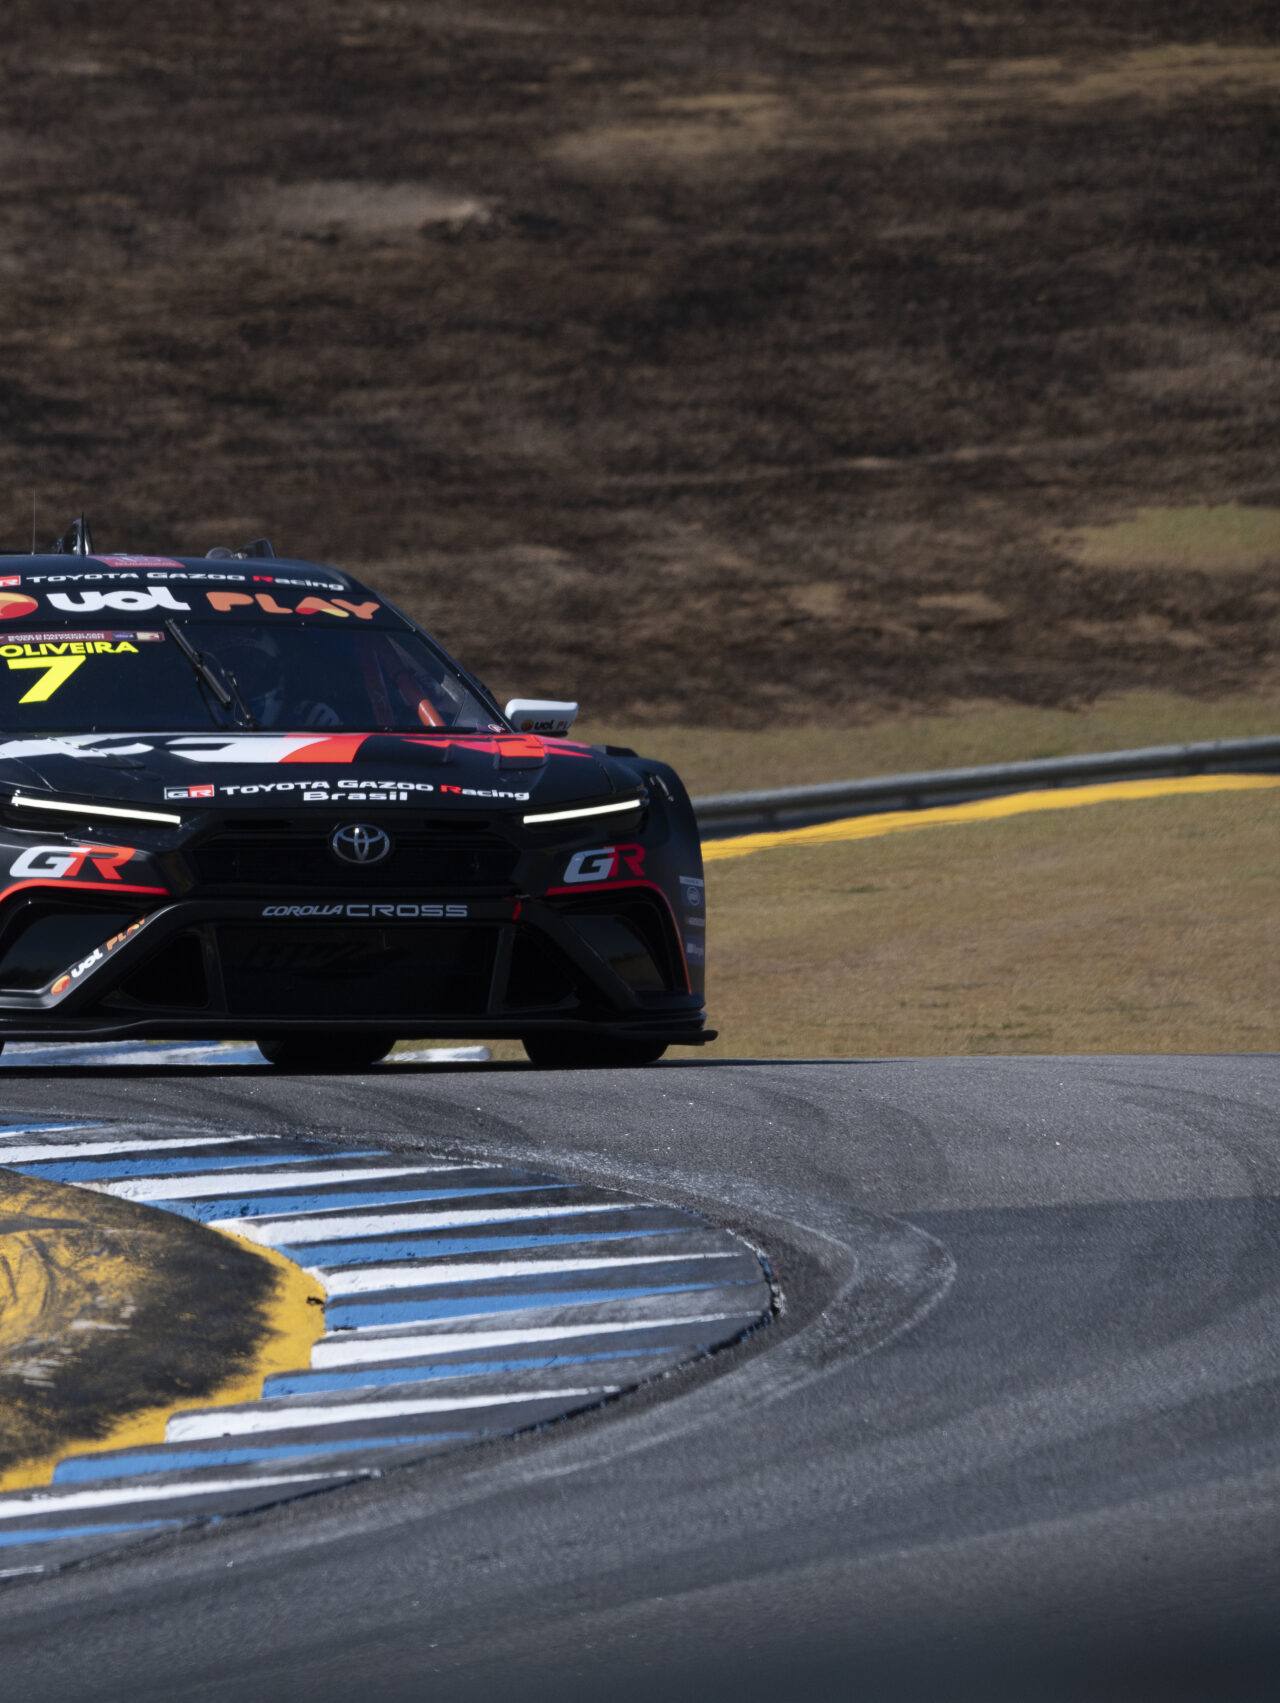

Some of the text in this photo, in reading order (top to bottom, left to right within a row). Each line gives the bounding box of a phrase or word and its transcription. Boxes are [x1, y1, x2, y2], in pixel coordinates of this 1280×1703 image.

[25, 572, 139, 584] TOYOTA
[252, 575, 345, 592] Racing
[205, 591, 381, 621] PLAY
[6, 655, 87, 704] 7
[167, 788, 215, 799] GR
[219, 781, 331, 796] TOYOTA
[440, 784, 531, 801] Racing
[303, 791, 409, 801] Brasil
[9, 845, 137, 880] GR
[563, 843, 647, 884] GR
[261, 904, 469, 918] COROLLA CROSS
